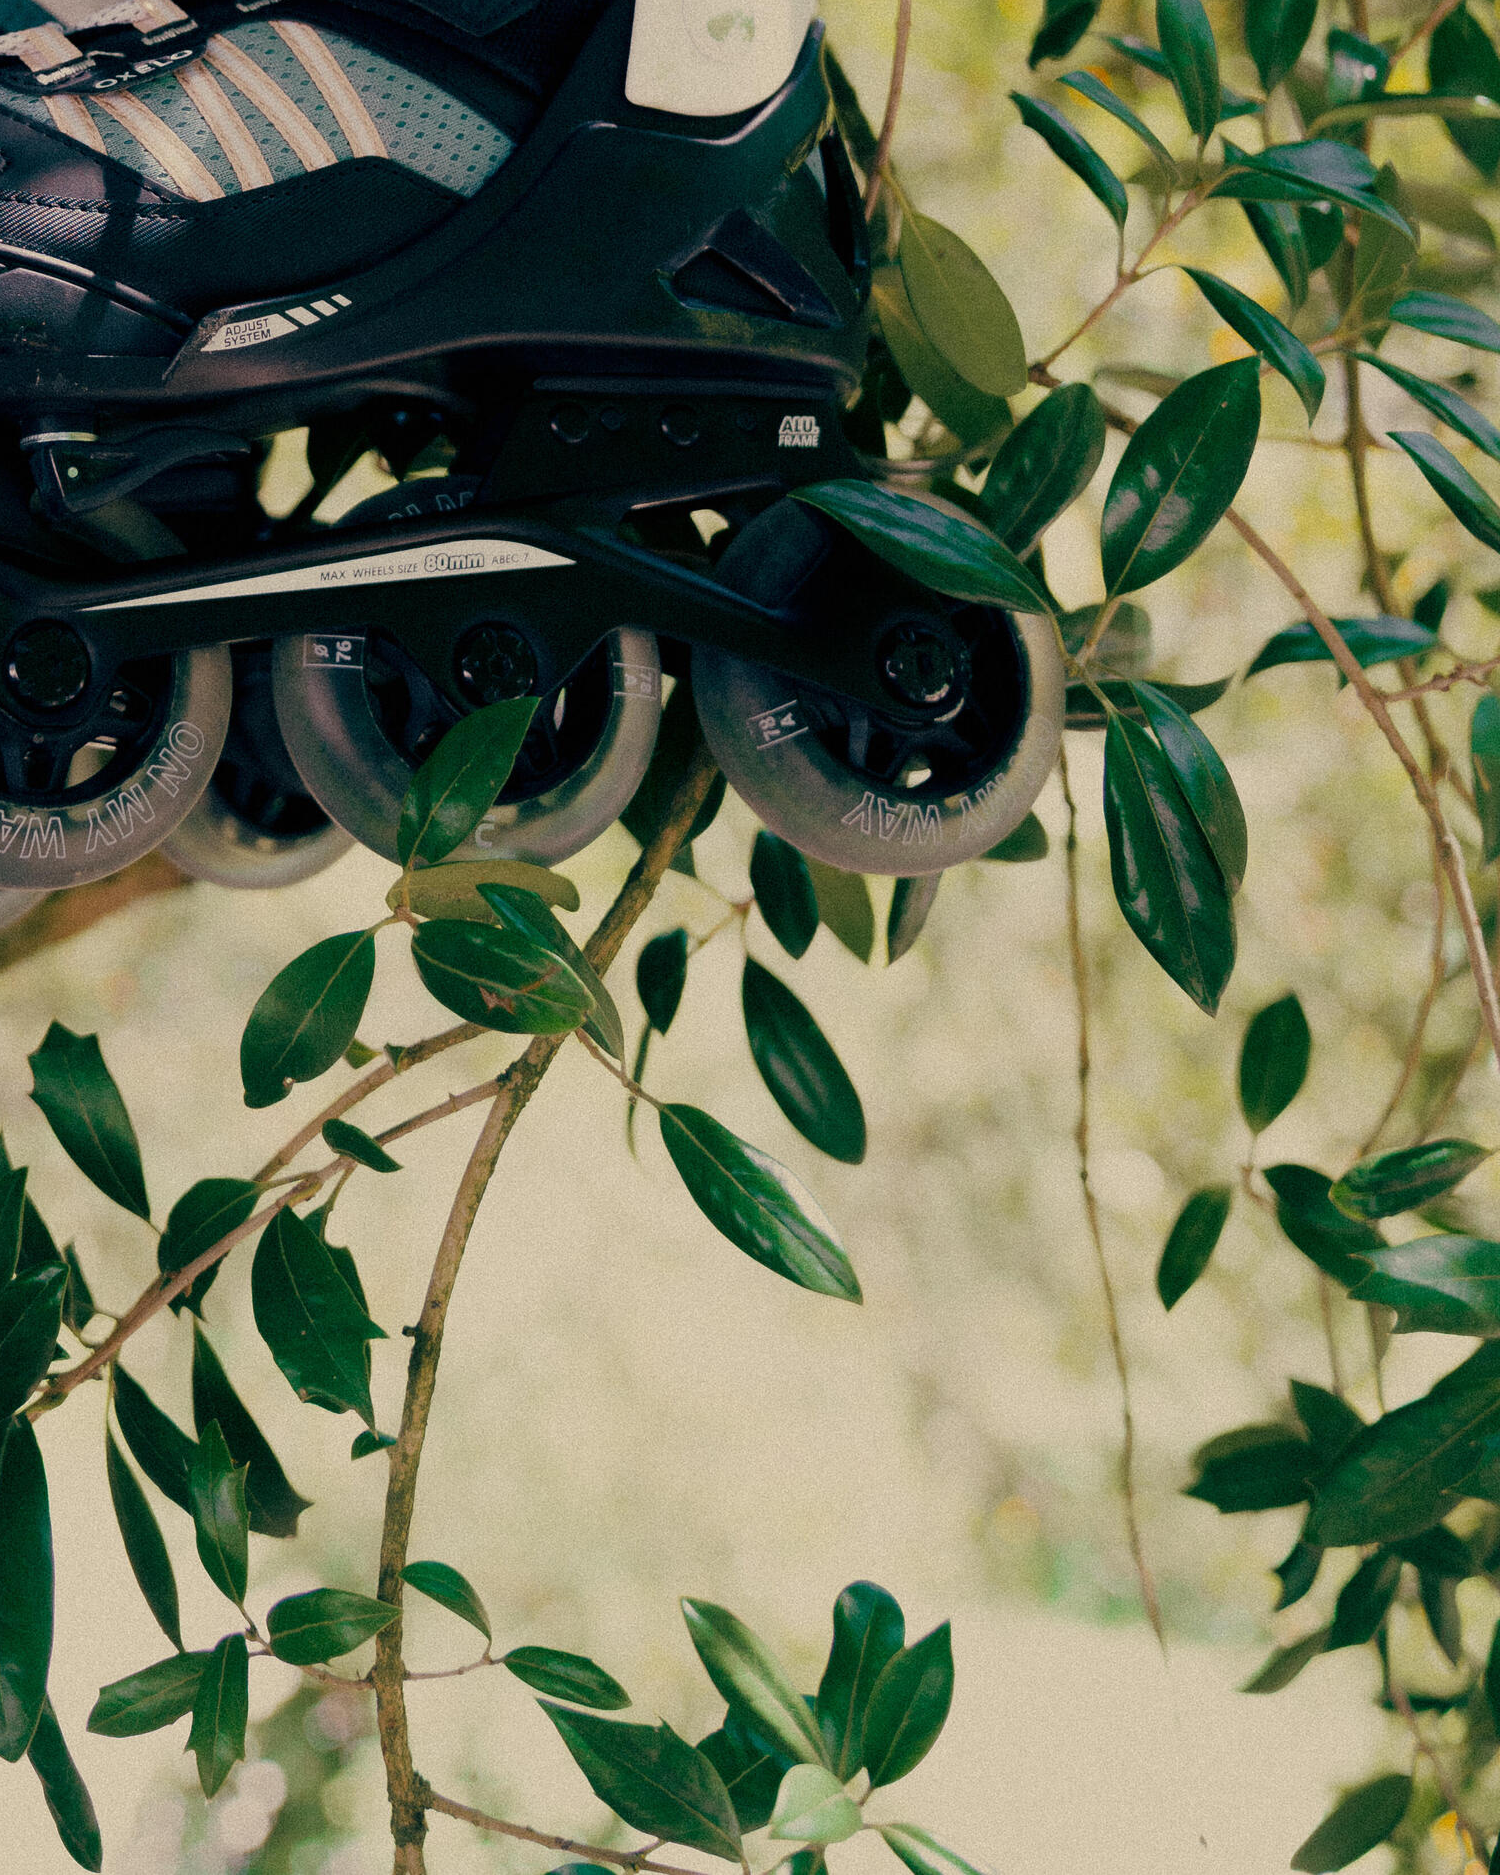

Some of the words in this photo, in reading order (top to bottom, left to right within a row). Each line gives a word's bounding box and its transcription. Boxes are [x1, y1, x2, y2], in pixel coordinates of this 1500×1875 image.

[94, 49, 194, 89] OXELO
[224, 328, 272, 348] SYSTEM
[225, 317, 269, 337] ADJUST
[778, 433, 819, 448] FRAME
[319, 570, 346, 581] MAX
[353, 565, 394, 579] WHEELS
[397, 562, 419, 574] SIZE
[423, 552, 485, 573] 80mm
[491, 554, 519, 566] ABEC
[522, 552, 530, 563] 7
[334, 639, 352, 663] 76
[758, 715, 781, 742] 78
[780, 712, 796, 727] A
[147, 720, 205, 799] ON
[85, 782, 156, 854] MY
[841, 790, 943, 846] WAY
